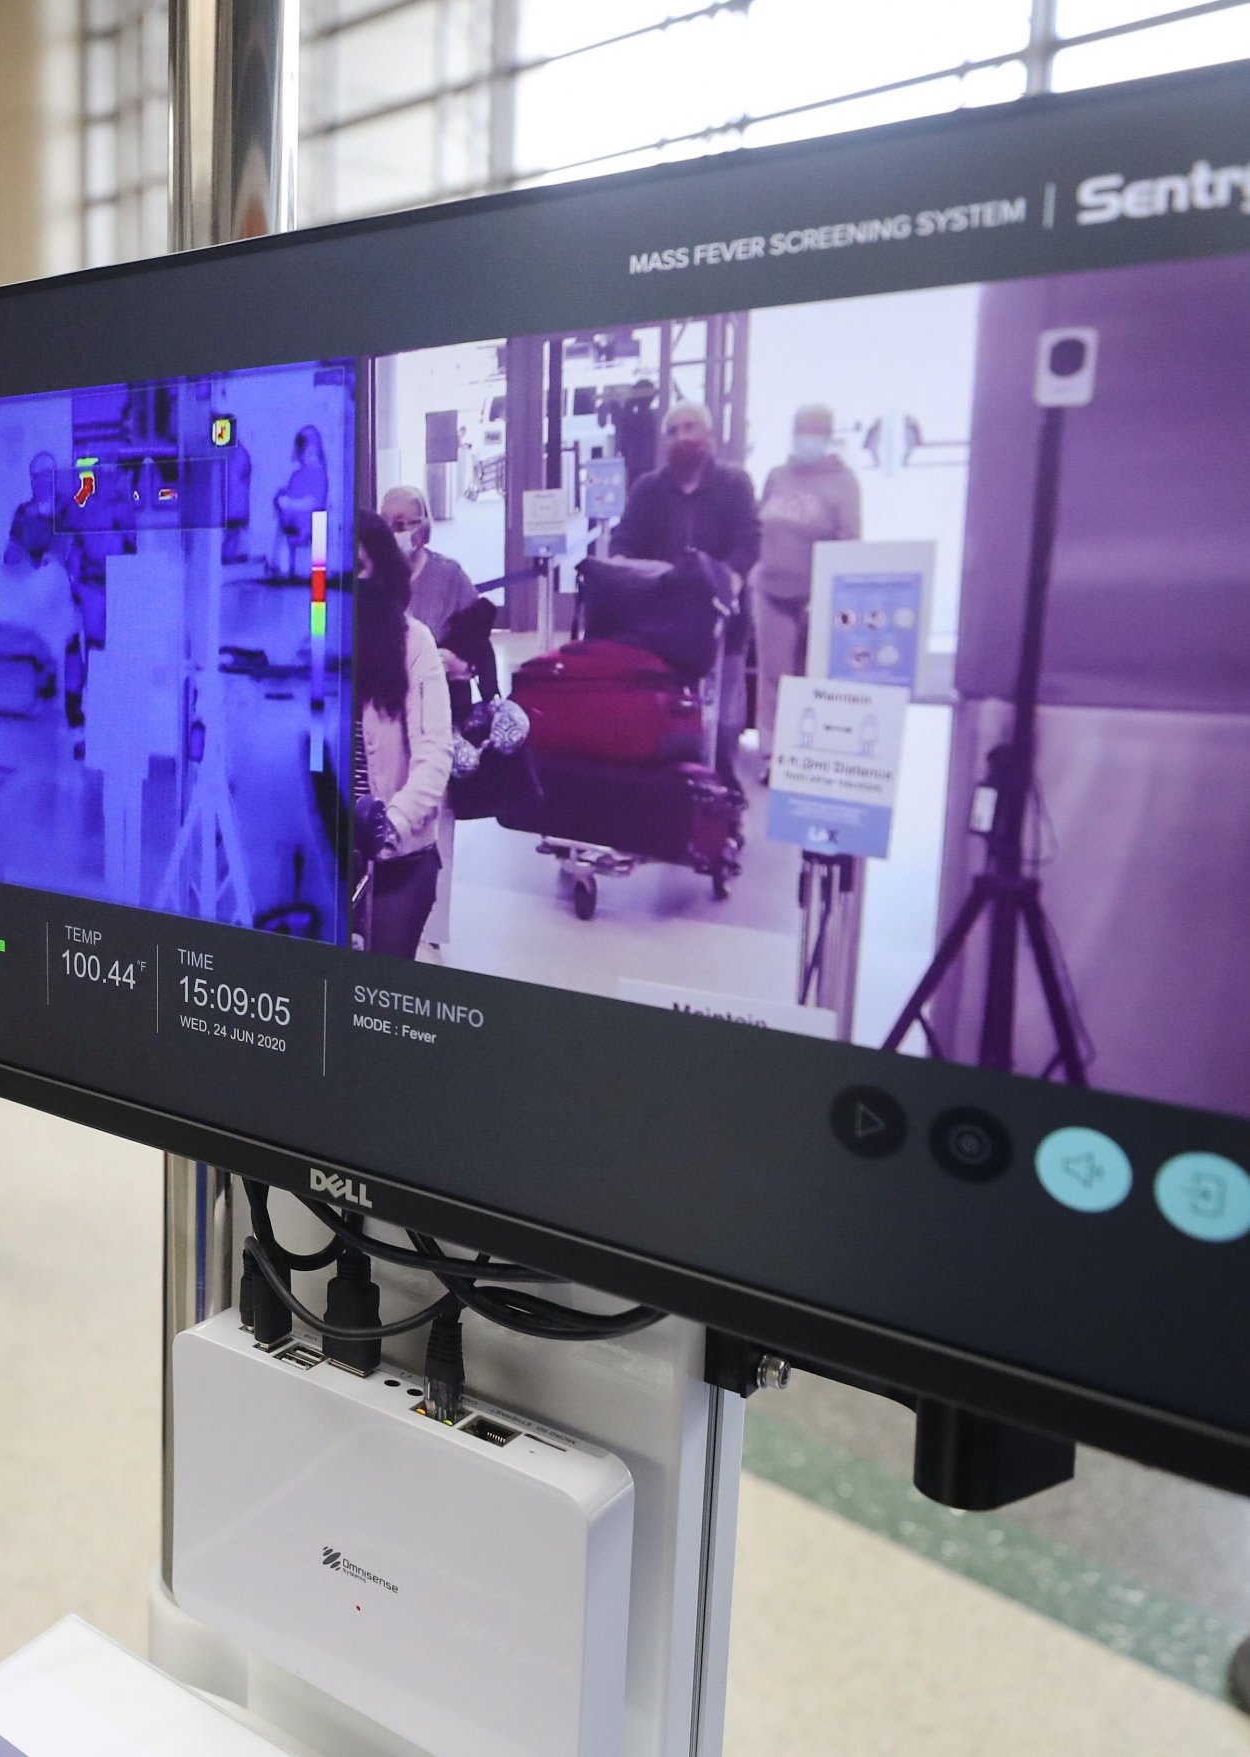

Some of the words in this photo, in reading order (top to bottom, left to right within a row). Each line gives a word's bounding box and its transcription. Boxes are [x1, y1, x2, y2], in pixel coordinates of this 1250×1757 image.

[629, 245, 690, 276] MASS
[693, 235, 766, 267] FEVER
[768, 213, 913, 256] SCREENING
[915, 197, 1028, 237] SYSTEM
[65, 925, 102, 947] TEMP
[61, 949, 136, 990] 100.44
[177, 948, 214, 971] TIME
[179, 975, 291, 1026] 15:09:05
[354, 985, 430, 1018] SYSTEM
[437, 1001, 484, 1029] INFO
[179, 1014, 210, 1035] WED,
[213, 1023, 227, 1038] 24
[230, 1027, 254, 1044] JUN
[257, 1034, 286, 1053] 2020
[353, 1014, 392, 1034] MODE
[402, 1024, 437, 1044] Fever
[310, 1167, 373, 1209] DELL
[342, 1558, 399, 1594] Omnisense
